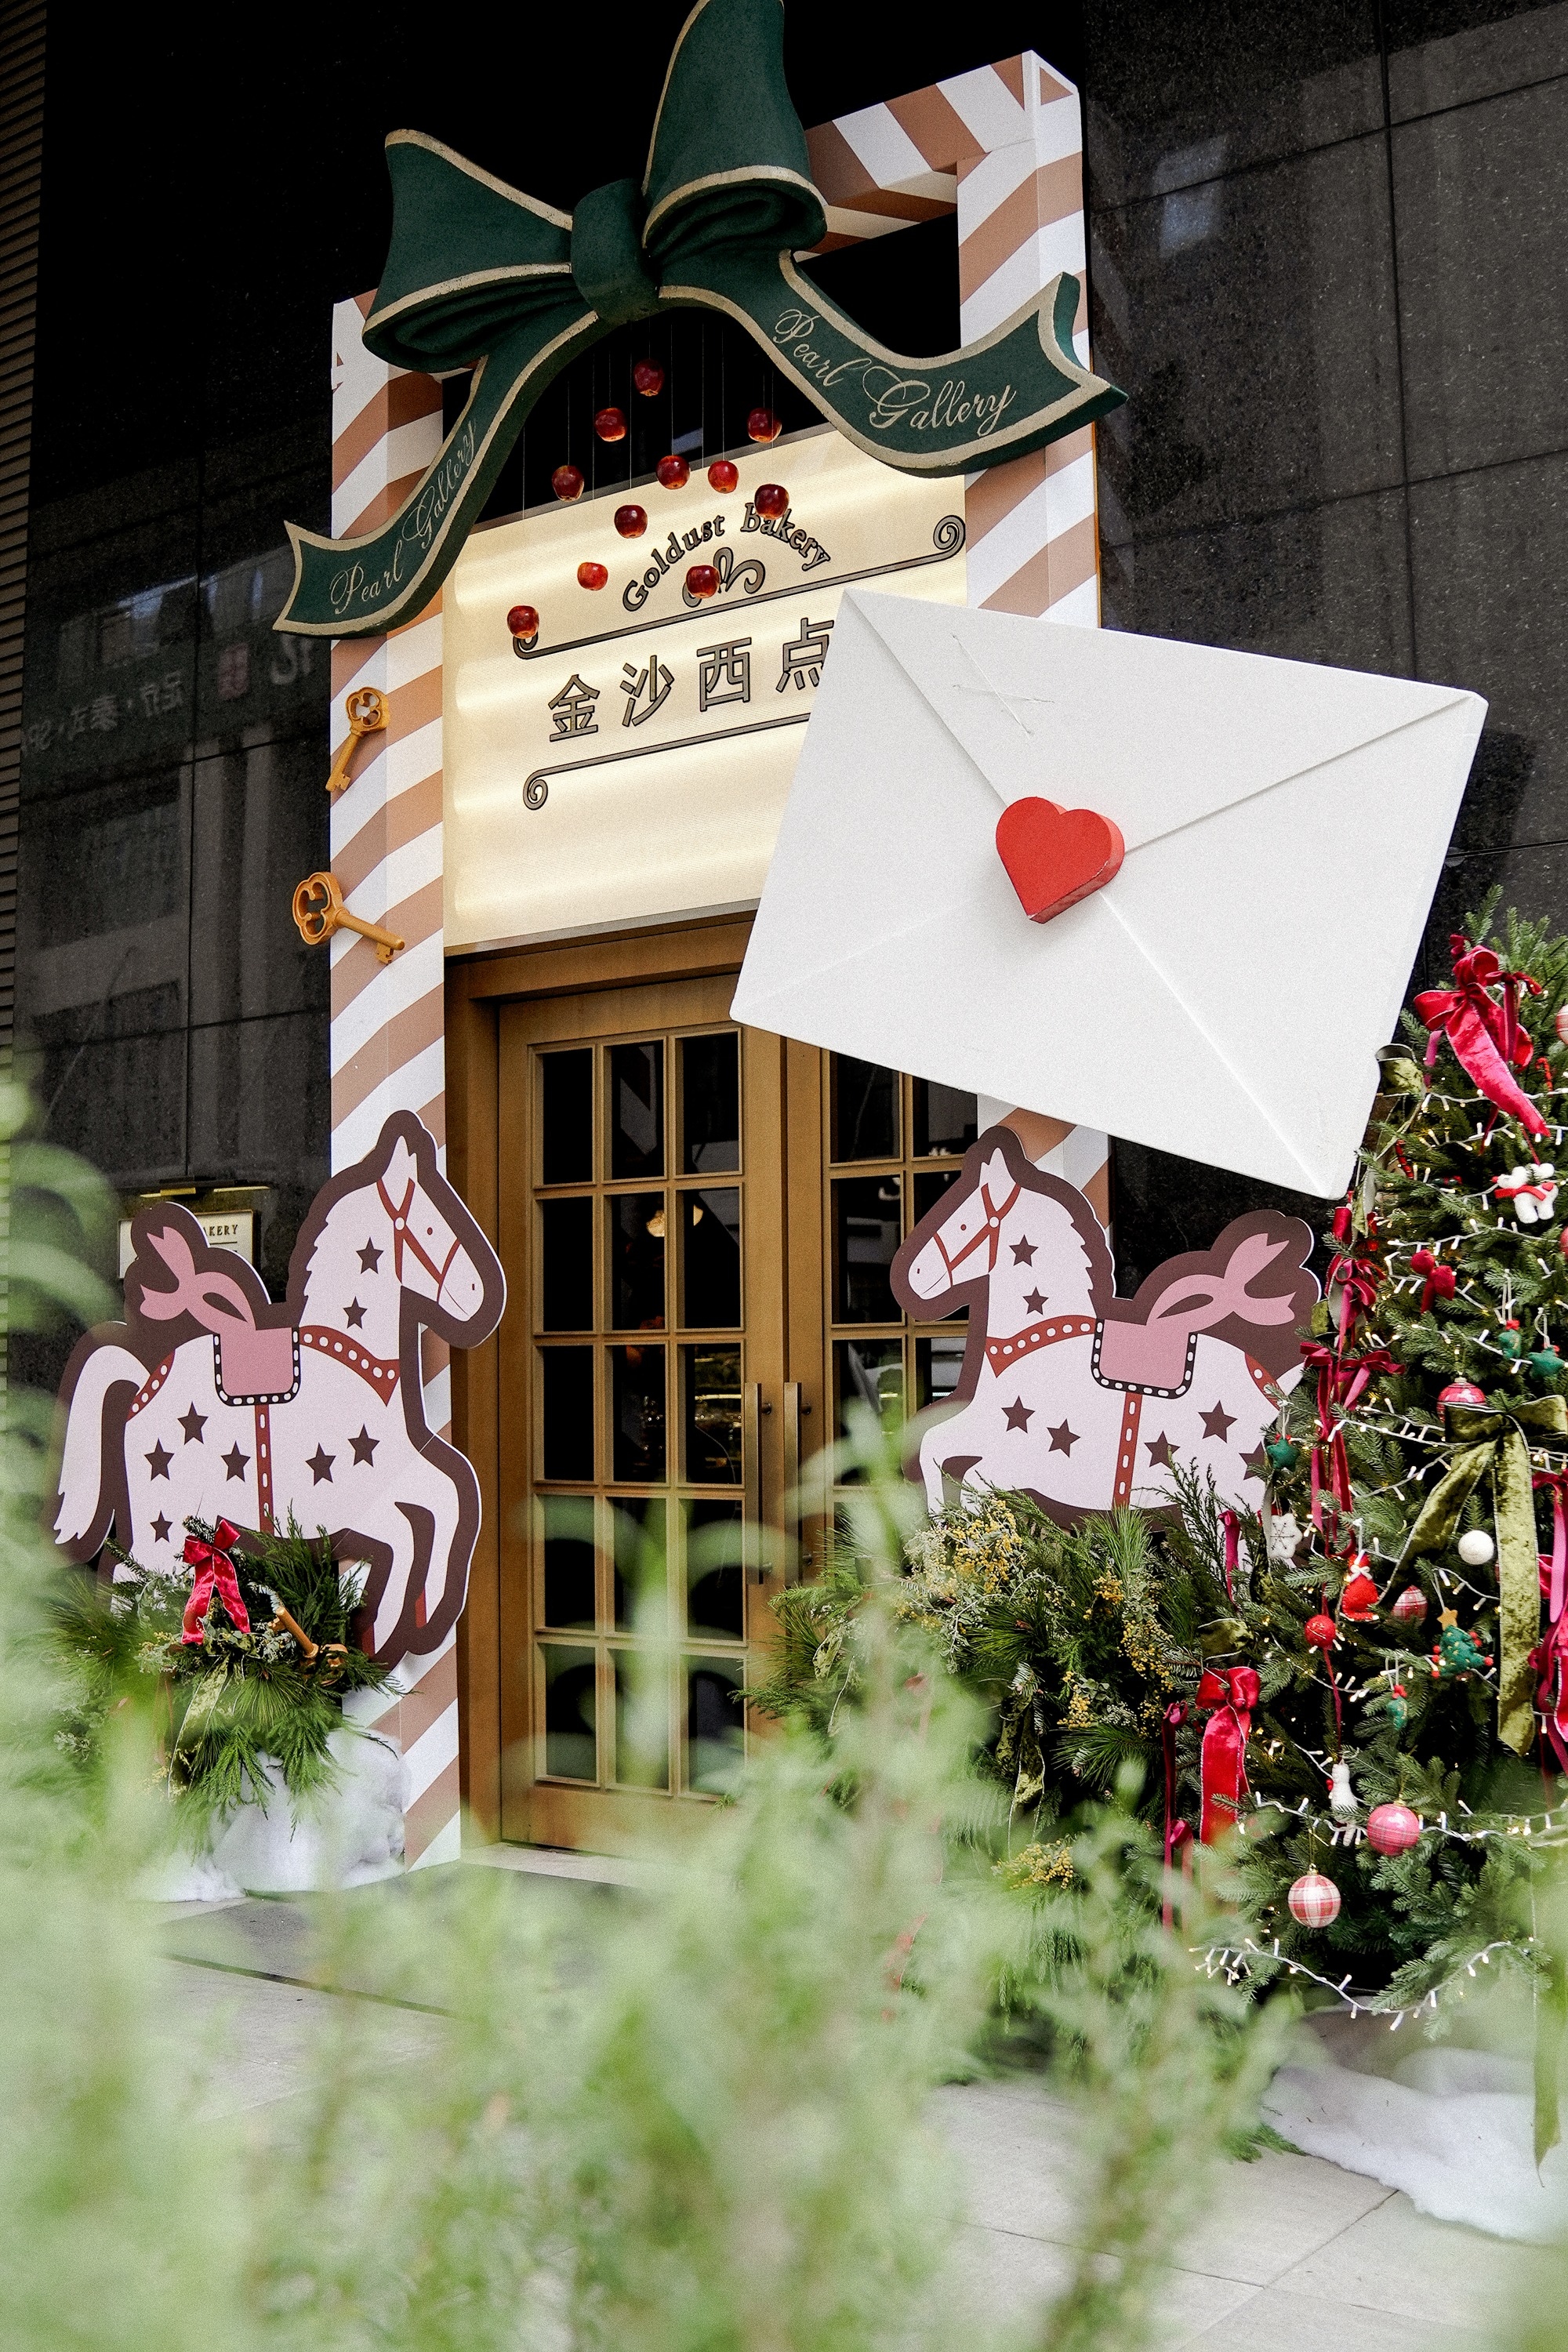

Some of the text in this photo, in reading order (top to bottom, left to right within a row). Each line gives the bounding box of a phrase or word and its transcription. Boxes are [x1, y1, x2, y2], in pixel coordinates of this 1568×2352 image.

[772, 307, 1017, 437] Pearl Gallery
[329, 419, 477, 615] Pearl Gallery
[622, 502, 831, 612] Goldust Bakery
[547, 617, 835, 742] 金沙西点
